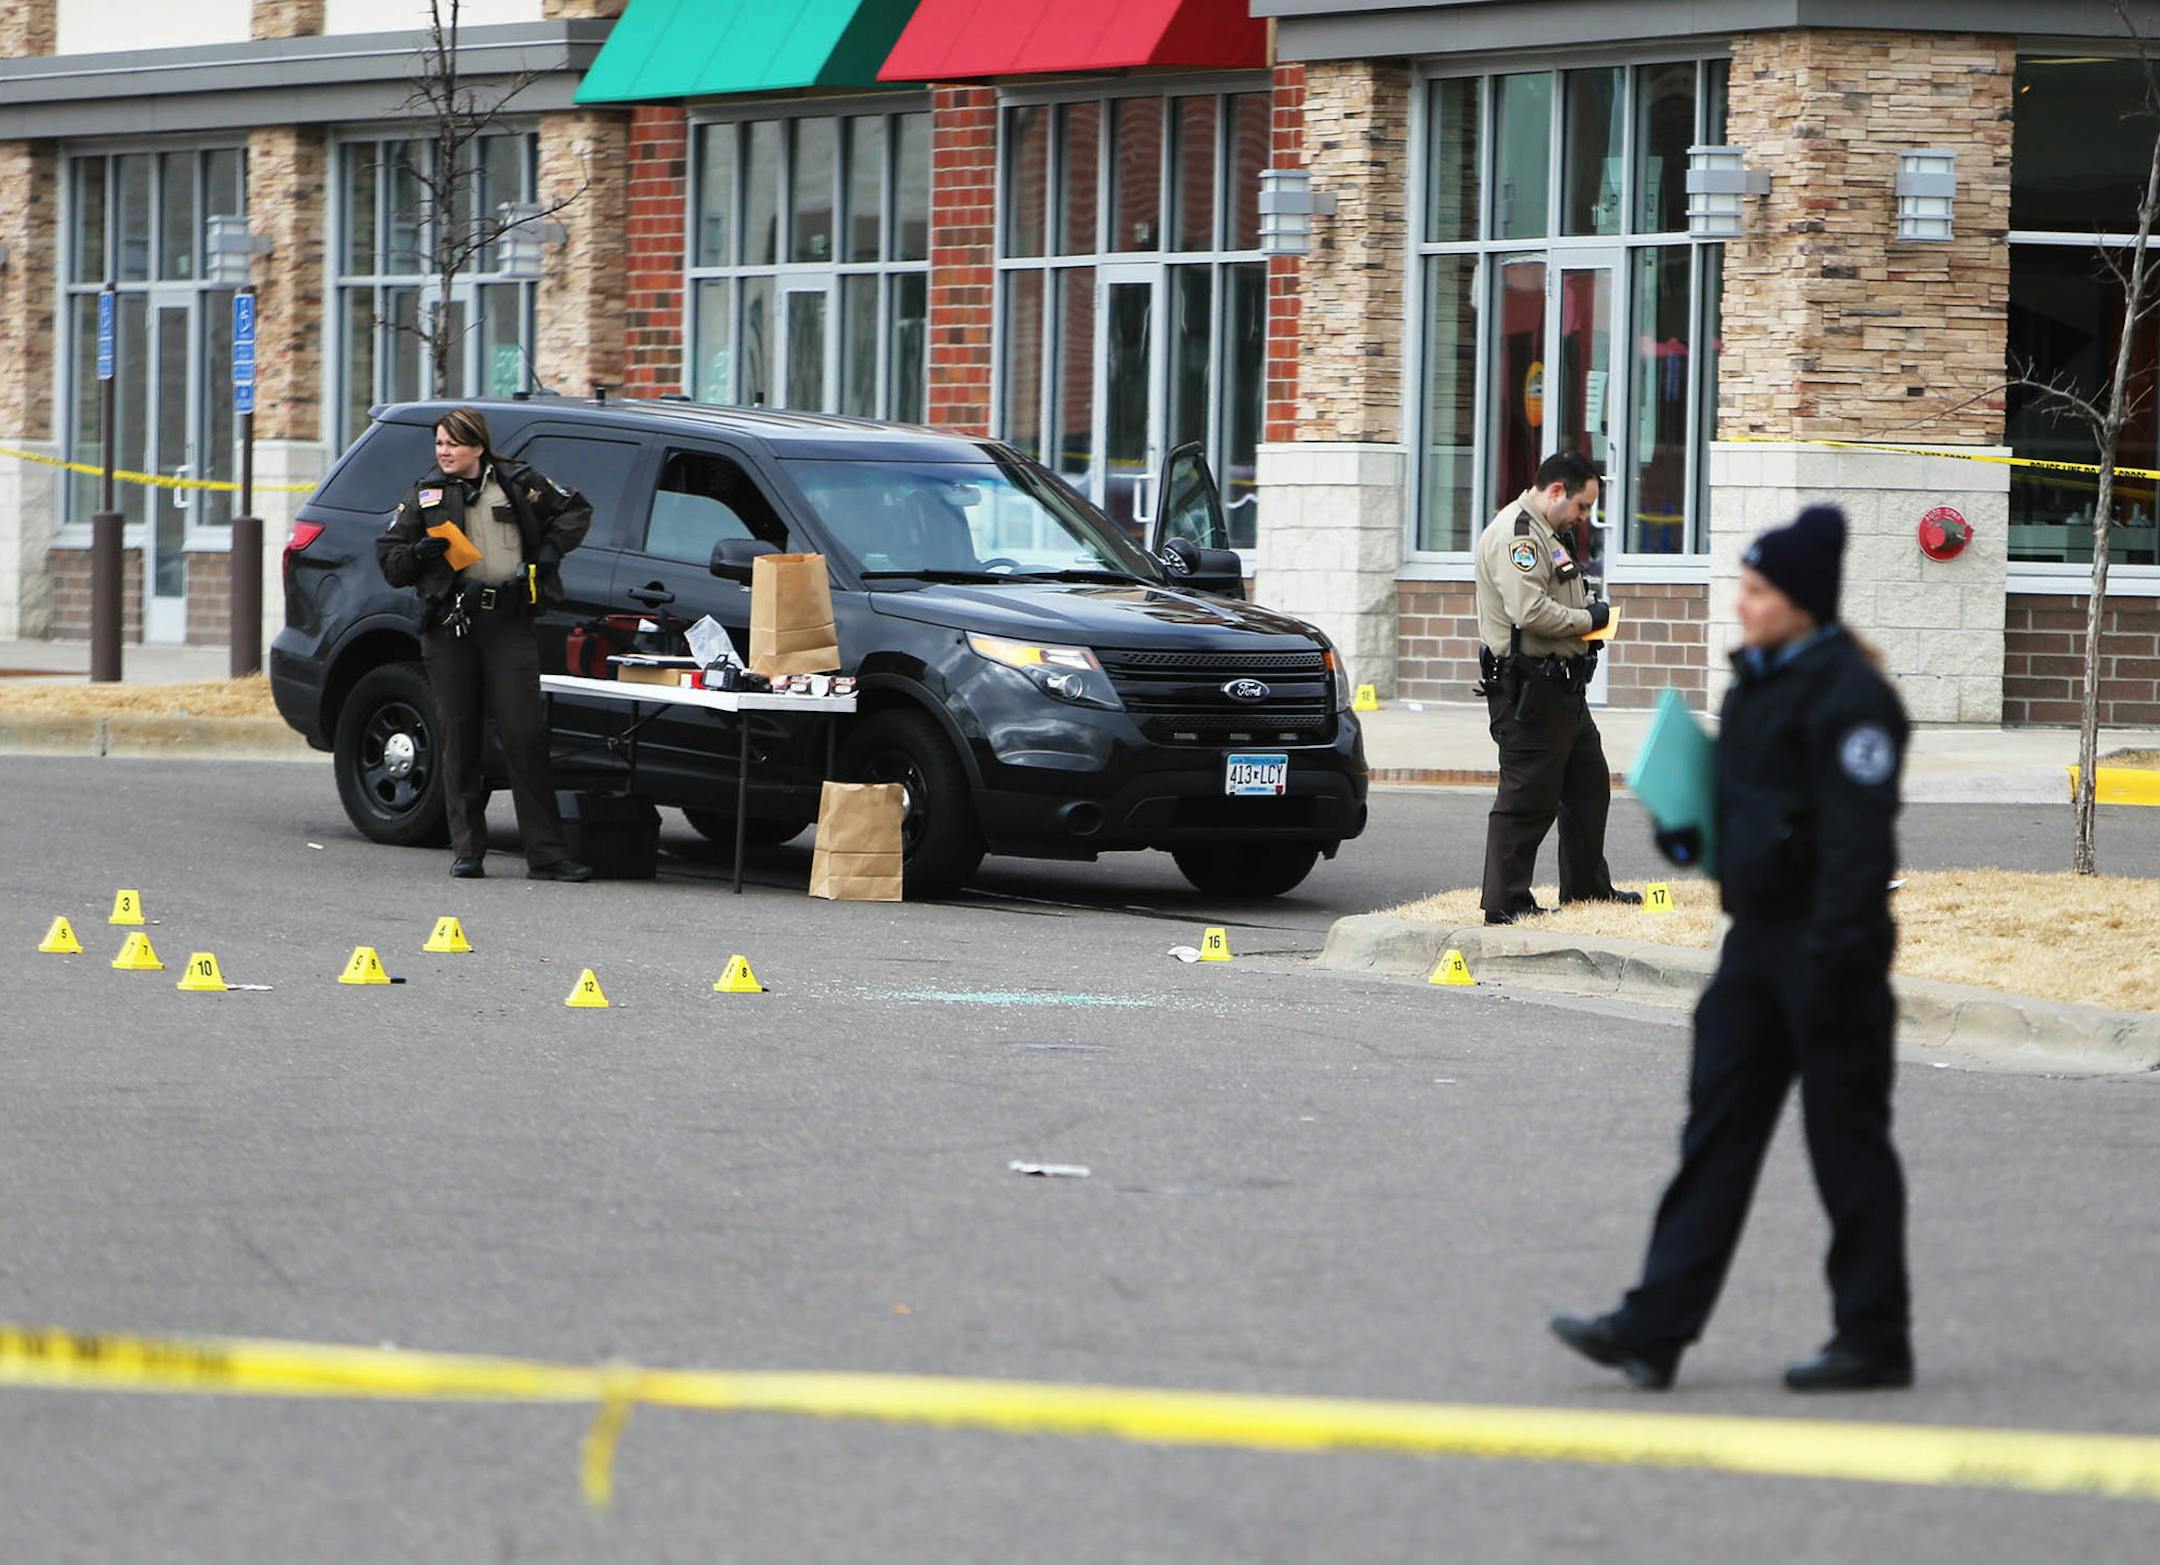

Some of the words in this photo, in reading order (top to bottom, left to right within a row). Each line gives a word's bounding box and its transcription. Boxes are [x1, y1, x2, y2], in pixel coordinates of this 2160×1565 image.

[1237, 682, 1261, 697] Ford
[1230, 765, 1252, 785] 413
[1261, 765, 1283, 784] LCY
[123, 897, 130, 911] 3
[1652, 890, 1665, 904] 17
[61, 929, 67, 939] 5
[1208, 934, 1221, 950] 16
[143, 945, 148, 956] 7
[198, 960, 212, 976] 10
[742, 967, 748, 978] 8
[1454, 960, 1463, 971] 13
[584, 981, 594, 992] 12
